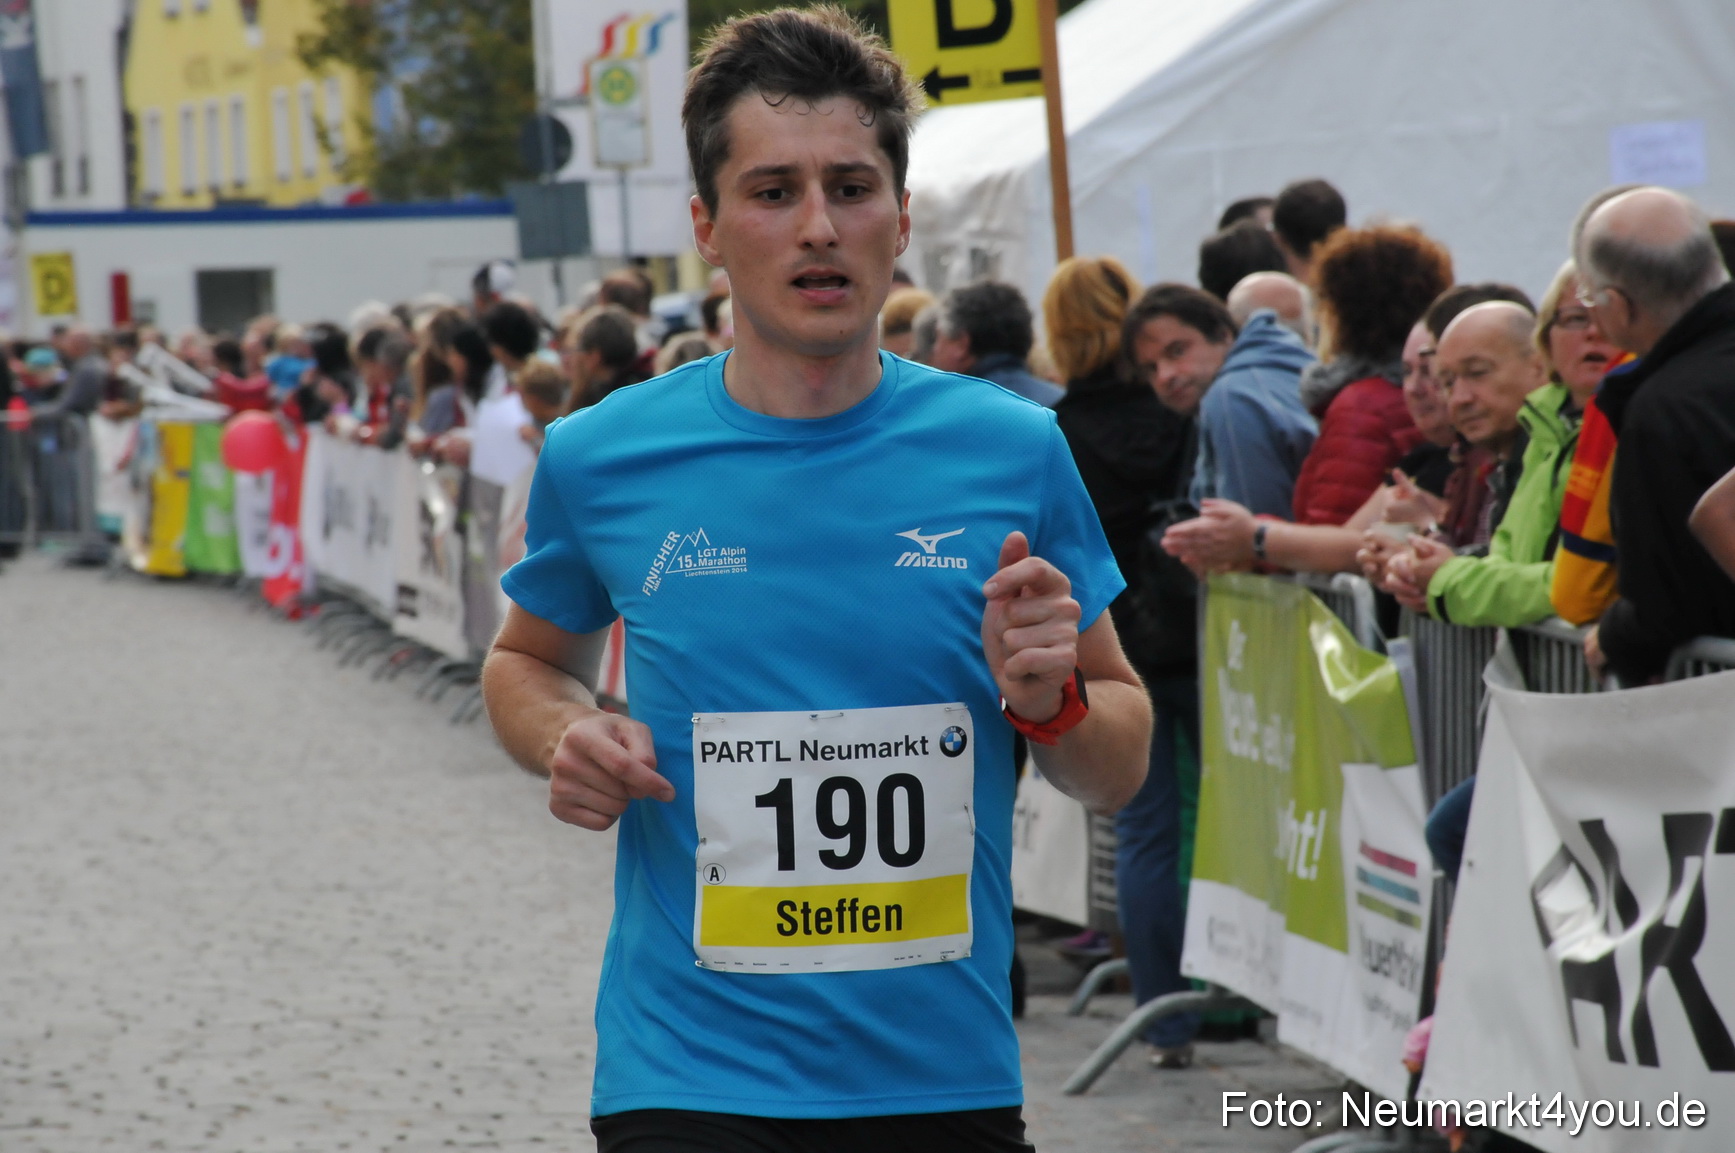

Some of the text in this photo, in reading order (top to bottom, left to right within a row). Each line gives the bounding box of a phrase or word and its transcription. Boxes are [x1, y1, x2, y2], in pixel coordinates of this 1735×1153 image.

[677, 555, 747, 569] 15. Marathon
[697, 546, 746, 558] LGT Alpin
[642, 530, 681, 597] FINISHER
[684, 568, 730, 578] Liechtenstein
[700, 735, 930, 764] PARTL Neumarkt
[755, 772, 926, 872] 190
[708, 866, 721, 882] A
[776, 897, 904, 937] Steffen
